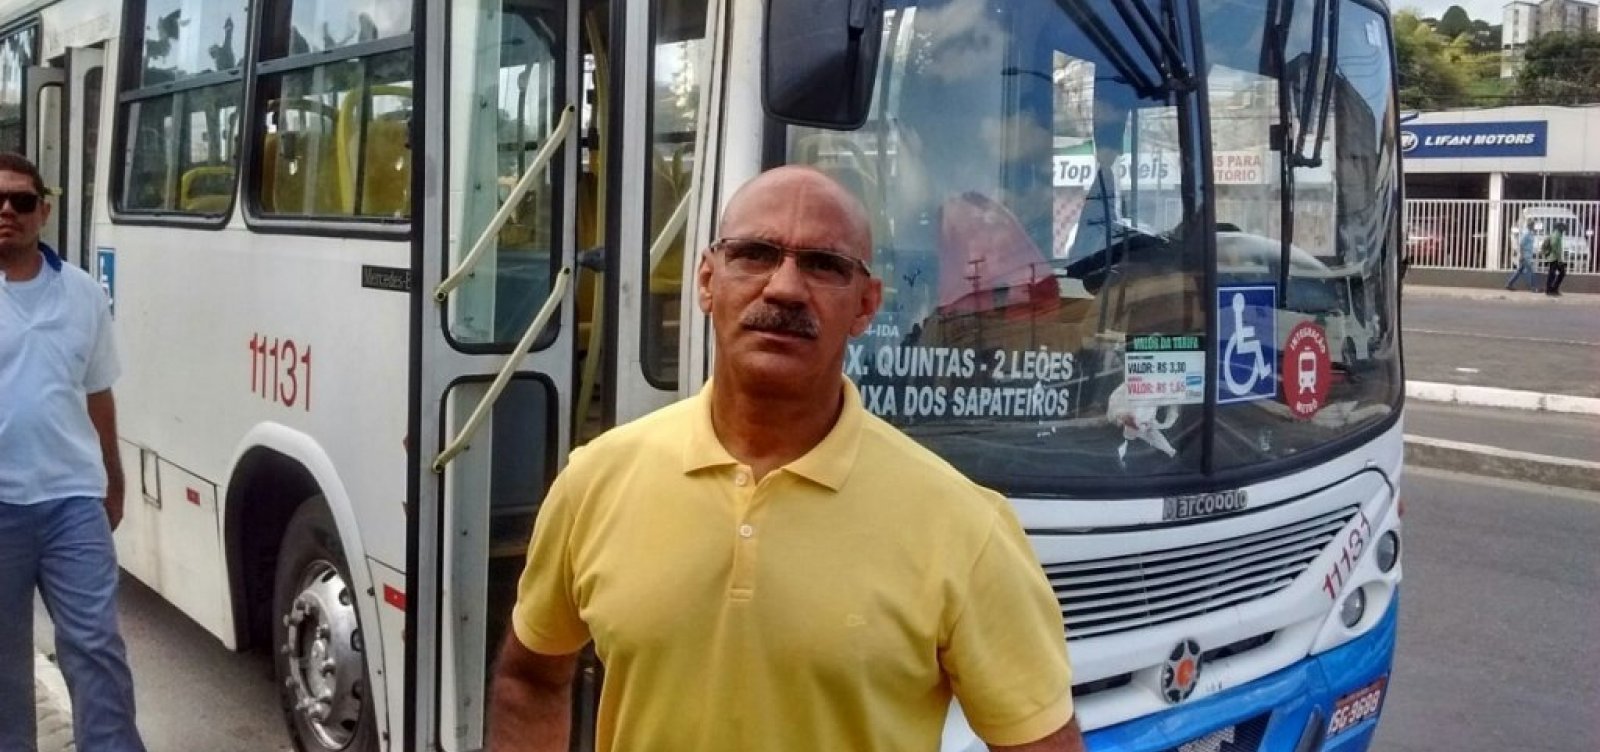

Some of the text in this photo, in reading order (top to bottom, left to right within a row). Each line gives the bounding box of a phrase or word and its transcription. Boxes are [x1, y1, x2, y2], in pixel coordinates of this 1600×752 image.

[1424, 133, 1536, 146] LIFAN MOTORS
[1060, 161, 1092, 183] Top
[1227, 155, 1261, 168] PARA
[248, 332, 312, 412] 11131
[876, 345, 976, 379] QUINTAS
[992, 348, 1006, 380] 2
[1010, 345, 1074, 382] LEÕES
[1127, 361, 1155, 374] VALOR:
[903, 385, 948, 416] DOS
[952, 385, 1070, 417] SAPATEIROS
[1322, 511, 1372, 600] 11131
